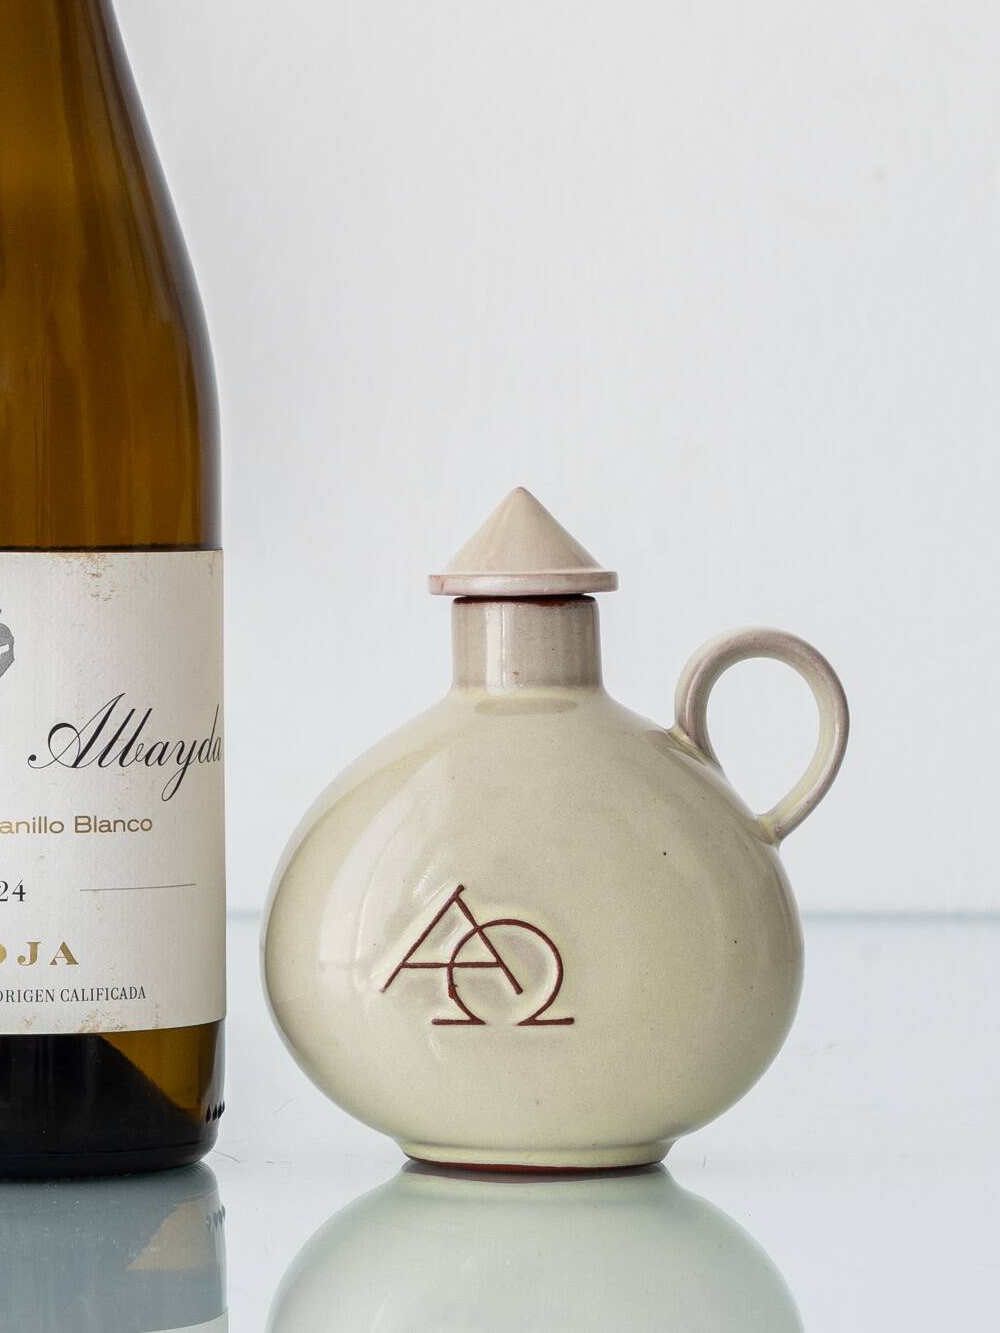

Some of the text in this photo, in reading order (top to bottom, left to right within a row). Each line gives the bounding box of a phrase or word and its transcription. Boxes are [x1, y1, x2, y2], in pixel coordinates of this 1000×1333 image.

[27, 692, 223, 802] Albayda
[74, 815, 153, 833] Blanco
[60, 984, 147, 1003] CALIFICADA
